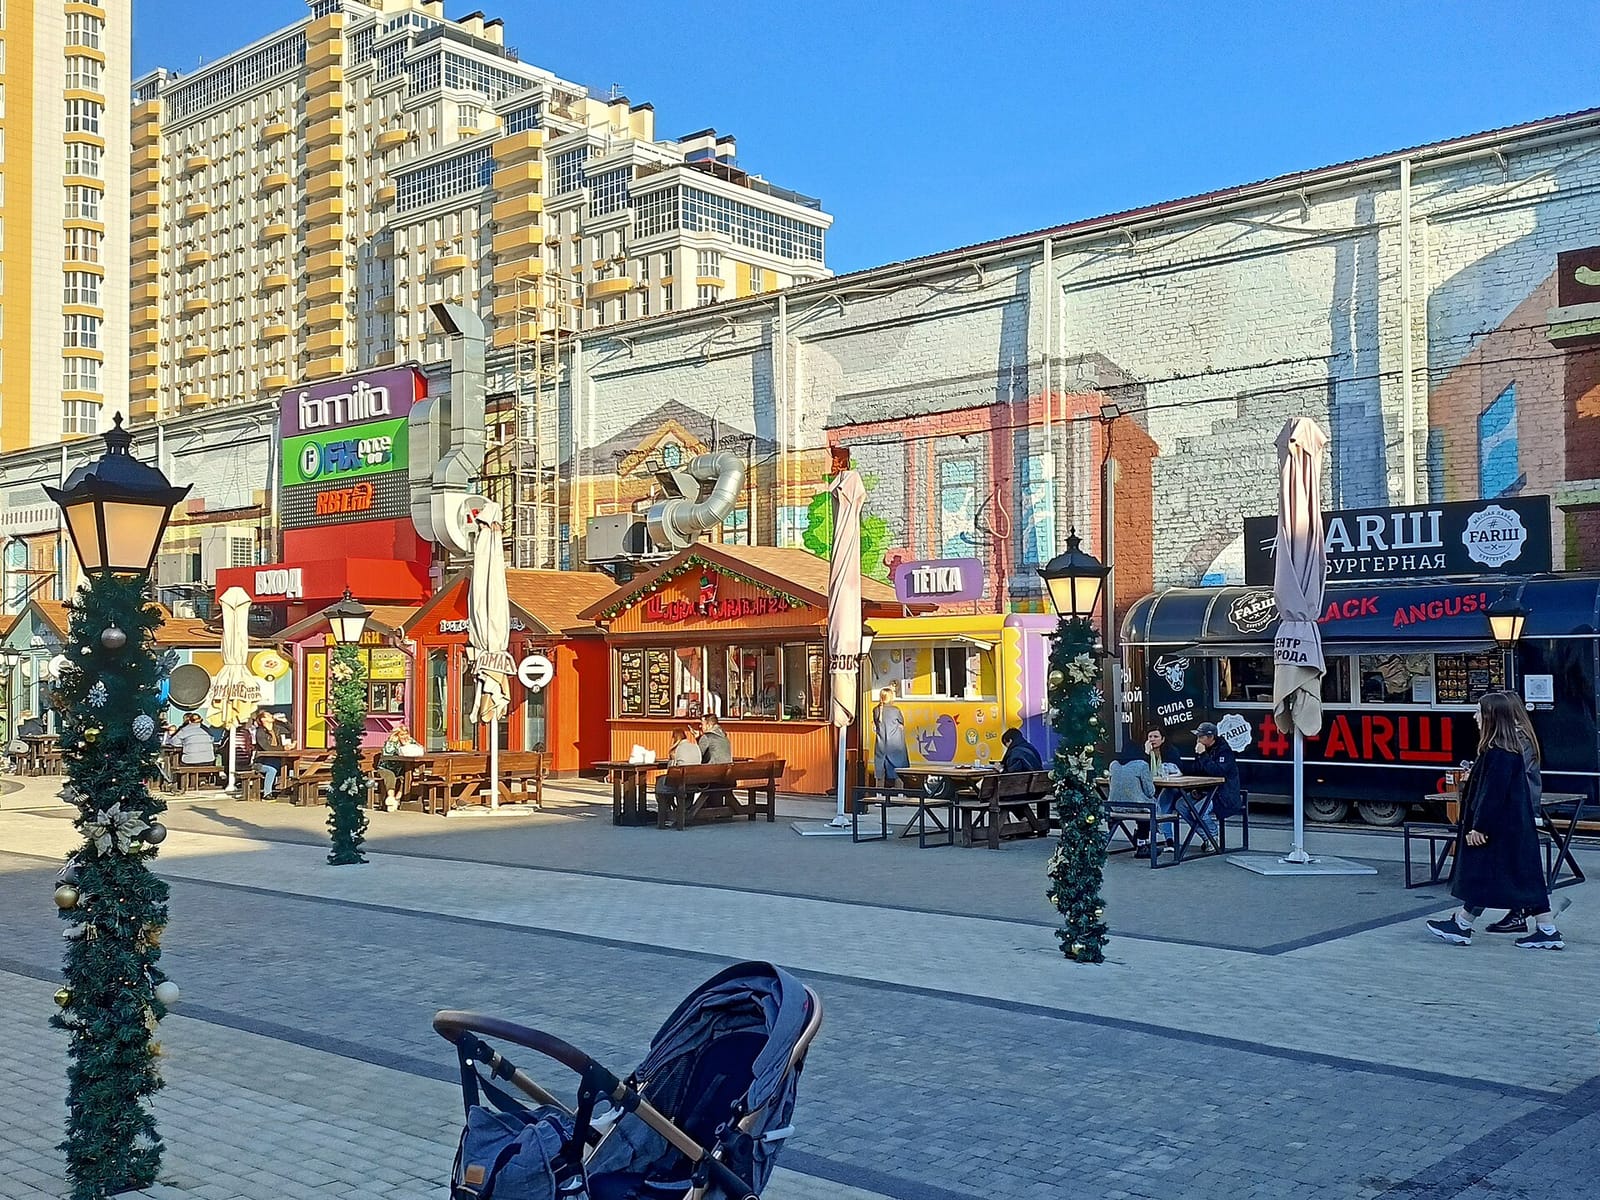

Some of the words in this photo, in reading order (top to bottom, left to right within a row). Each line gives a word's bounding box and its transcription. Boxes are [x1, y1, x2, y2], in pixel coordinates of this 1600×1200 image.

[299, 380, 391, 430] familia
[1469, 528, 1519, 543] FARШ
[1325, 553, 1447, 574] БУРГЕРНАЯ
[255, 568, 303, 599] ВХОД
[1392, 592, 1488, 627] ANGUS!
[1157, 700, 1185, 715] СИЛА
[1186, 699, 1194, 708] В
[1163, 711, 1194, 727] МЯСЕ
[1257, 713, 1453, 762] #ARШ
